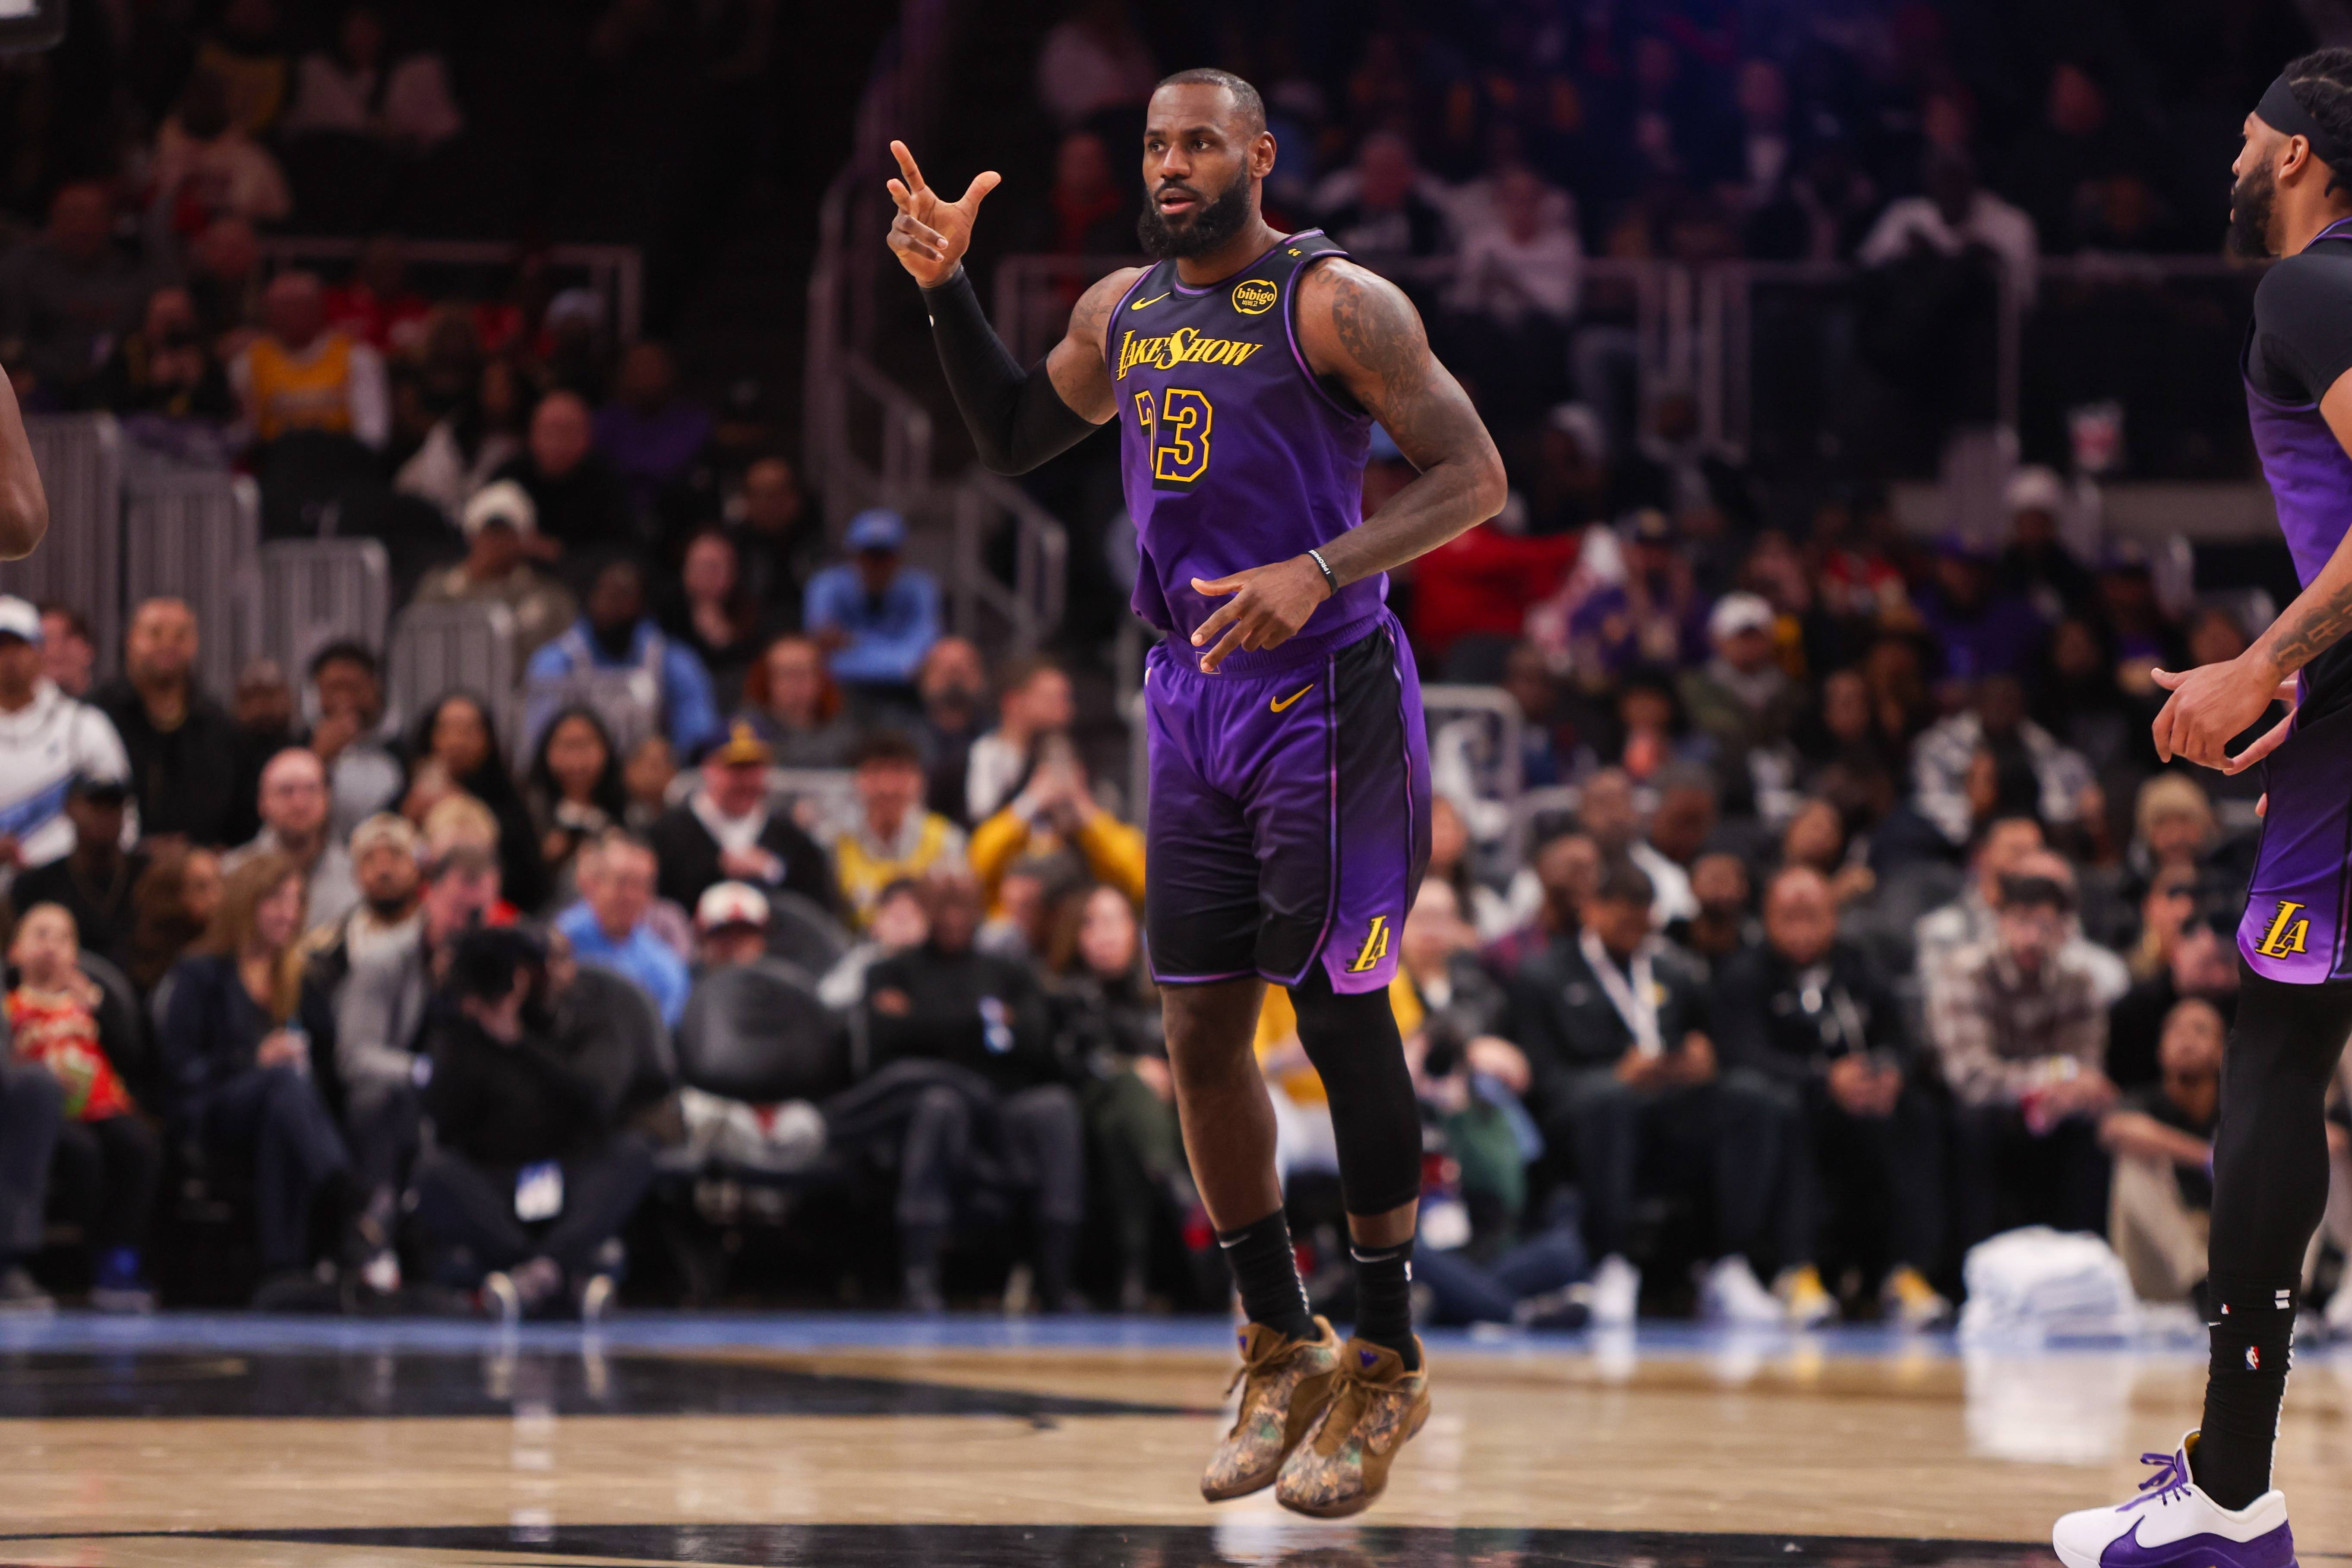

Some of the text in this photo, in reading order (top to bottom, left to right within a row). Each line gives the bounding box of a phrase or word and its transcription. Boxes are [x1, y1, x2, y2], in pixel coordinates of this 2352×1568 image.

[1288, 248, 1302, 256] 44
[1237, 287, 1275, 305] bibigo
[1309, 549, 1329, 572] PROMISE
[2255, 900, 2310, 959] LA
[1346, 915, 1389, 972] LA
